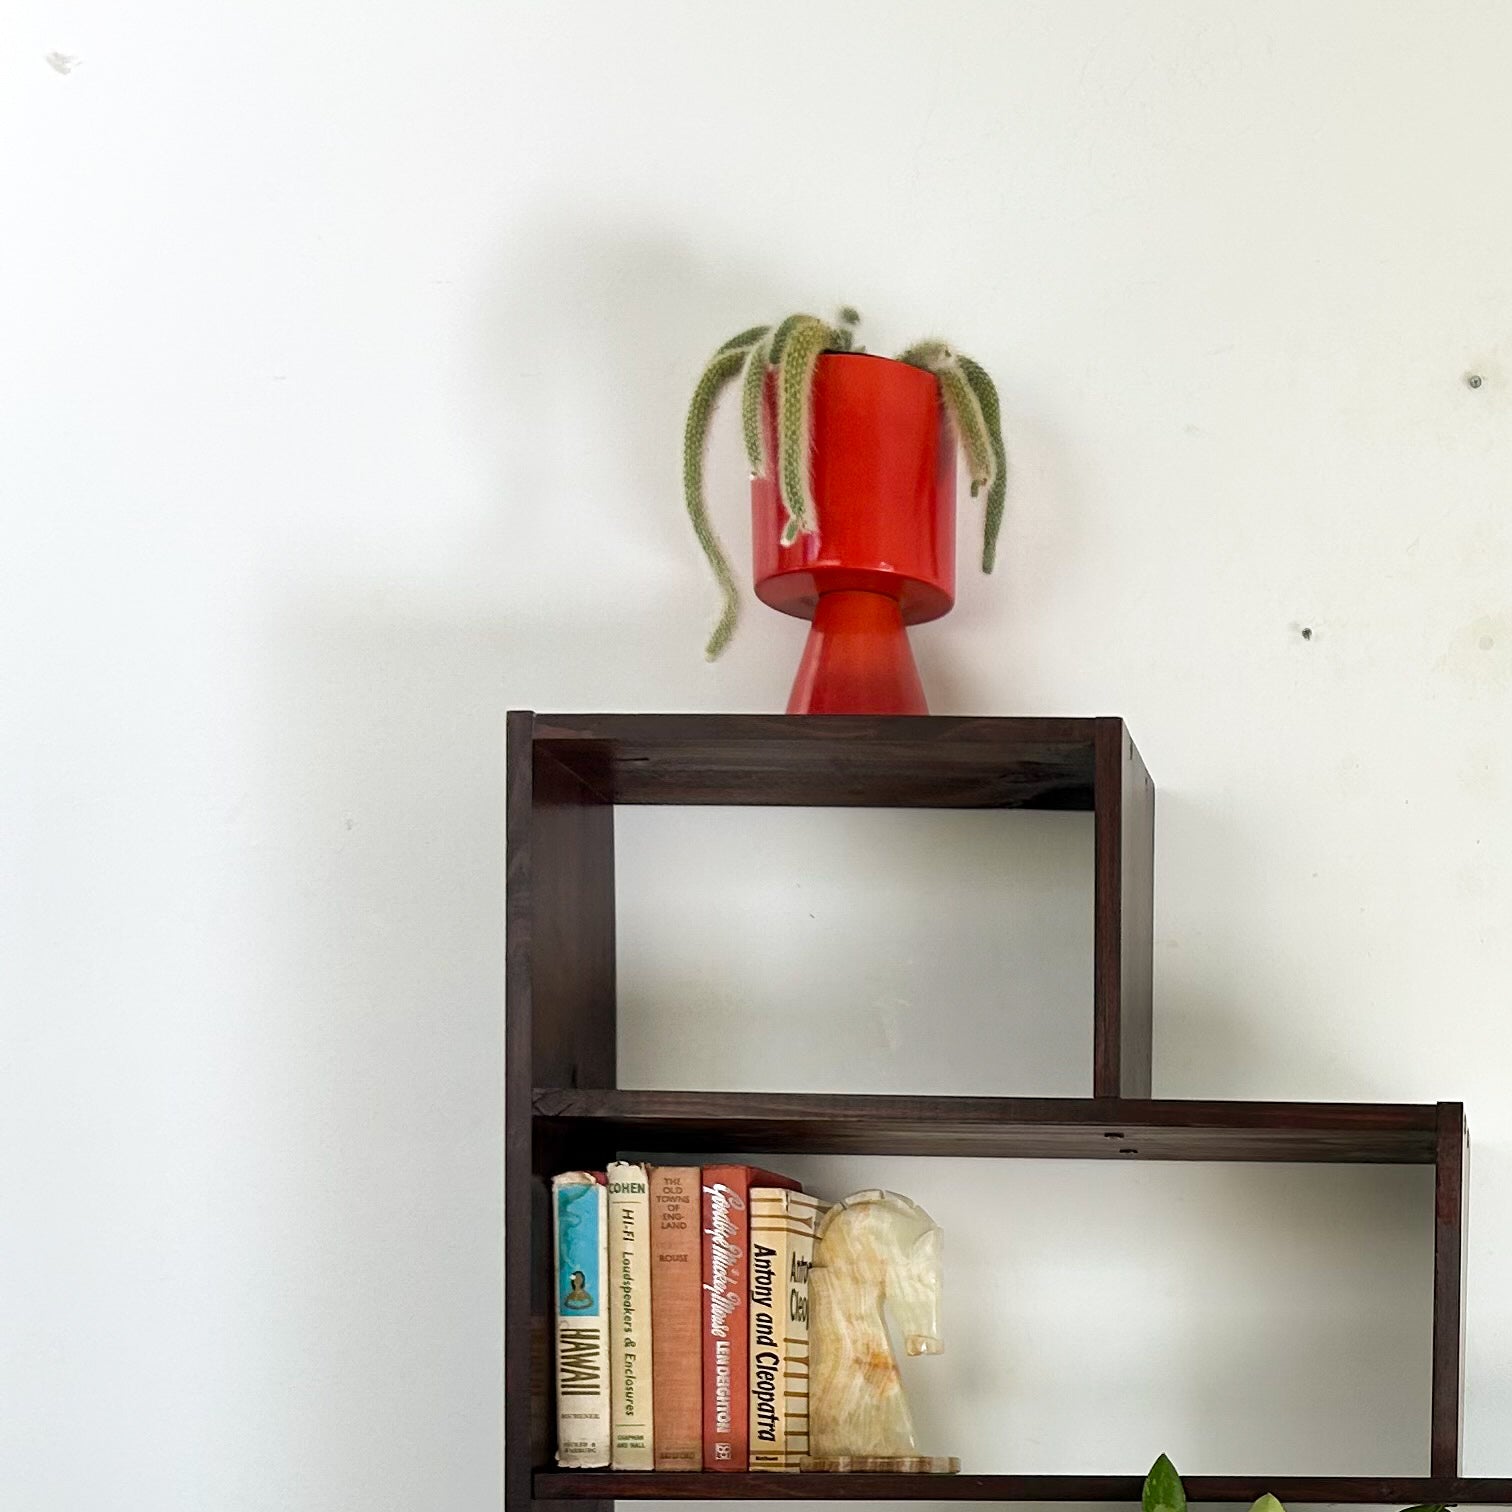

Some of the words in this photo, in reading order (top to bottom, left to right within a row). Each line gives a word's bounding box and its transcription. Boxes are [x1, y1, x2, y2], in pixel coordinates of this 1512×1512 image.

[608, 1183, 646, 1194] COHEN
[667, 1204, 680, 1212] OF
[622, 1208, 635, 1242] HI-FI
[661, 1222, 688, 1230] LAND
[703, 1183, 746, 1247] Goodbye
[620, 1252, 636, 1333] Loudspeakers
[703, 1244, 743, 1293] Mickey
[752, 1243, 777, 1309] Antony
[711, 1291, 741, 1338] Mouse
[755, 1312, 779, 1348] and
[559, 1328, 601, 1396] HAWAII
[624, 1337, 637, 1348] &
[716, 1341, 731, 1365] LEN
[624, 1354, 637, 1416] Enclosures
[716, 1365, 731, 1433] DEIGHTON
[751, 1351, 780, 1442] Cleopatra
